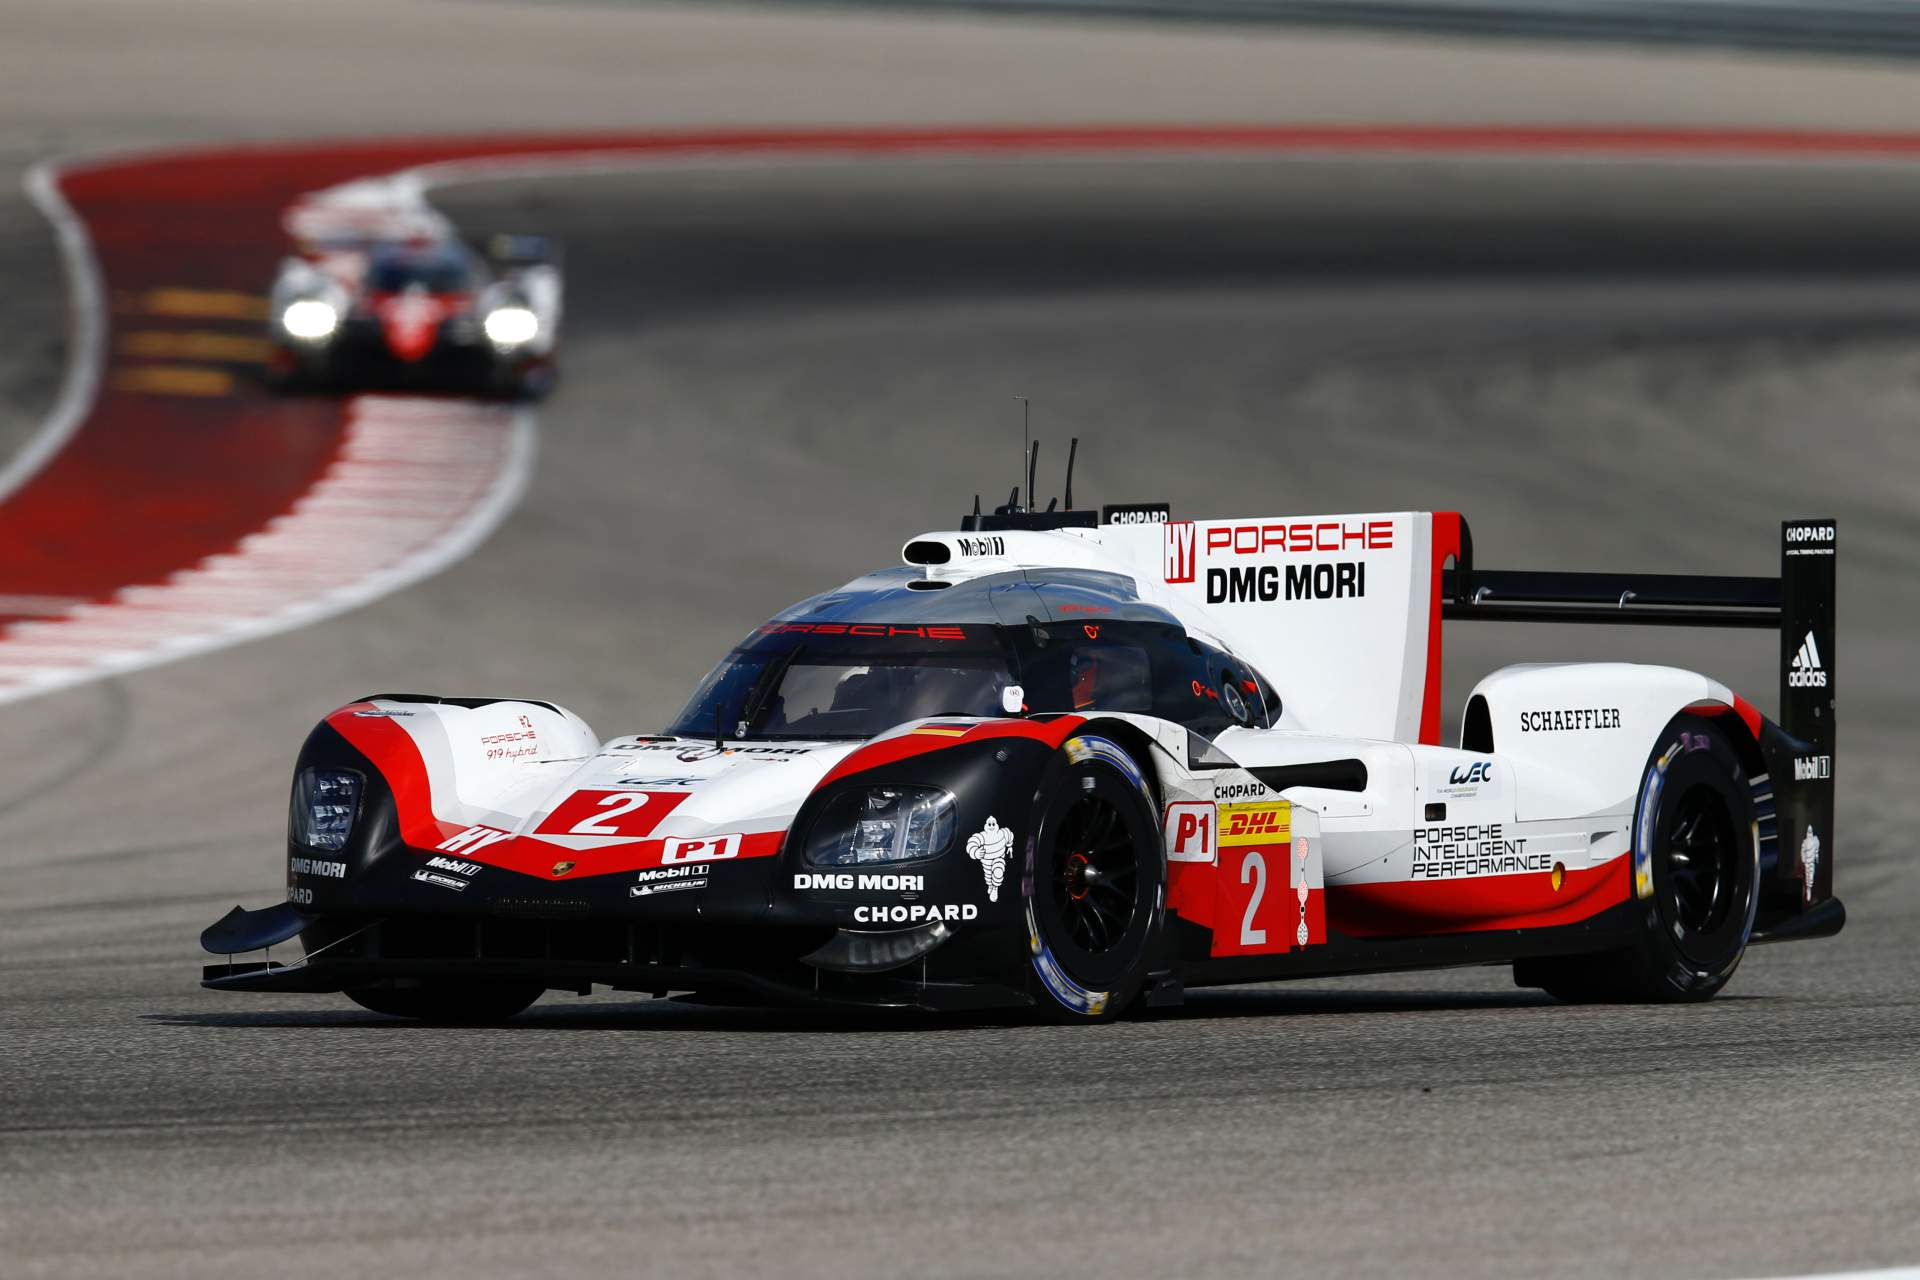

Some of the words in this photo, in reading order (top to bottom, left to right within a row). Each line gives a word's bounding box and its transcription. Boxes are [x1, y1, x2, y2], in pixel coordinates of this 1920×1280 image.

[1110, 511, 1168, 524] CHOPARD
[1207, 521, 1393, 556] PORSCHE
[1786, 526, 1834, 542] CHOPARD
[957, 537, 993, 557] Mobil
[1164, 521, 1194, 581] HY
[1207, 565, 1279, 604] DMG
[1285, 561, 1365, 601] MORI
[1789, 666, 1826, 687] adidas
[1521, 708, 1621, 732] SCHAEFFLER
[481, 731, 536, 744] PORSCHE
[486, 748, 503, 760] 919
[505, 744, 538, 764] hybrid
[612, 744, 705, 752] DMG
[708, 747, 813, 755] MORI
[1449, 761, 1492, 785] WEC
[1794, 756, 1818, 781] Mobil
[617, 777, 707, 786] WEC
[1214, 783, 1266, 799] CHOPARD
[568, 792, 649, 834] 2
[1229, 811, 1280, 835] DHL
[435, 825, 509, 855] HY
[1174, 813, 1209, 853] P1
[1414, 824, 1502, 844] PORSCHE
[675, 838, 728, 859] P1
[1413, 839, 1527, 861] INTELLIGENT
[291, 857, 311, 874] DMG
[311, 859, 347, 878] MORI
[425, 856, 469, 873] Mobil
[638, 866, 690, 882] Mobil
[1411, 854, 1551, 878] PERFORMANCE
[428, 874, 467, 888] MICHELIN
[652, 880, 705, 892] MICHELIN
[794, 874, 854, 890] DMG
[858, 874, 924, 891] MORI
[1240, 851, 1267, 946] 2
[854, 904, 978, 923] CHOPARD
